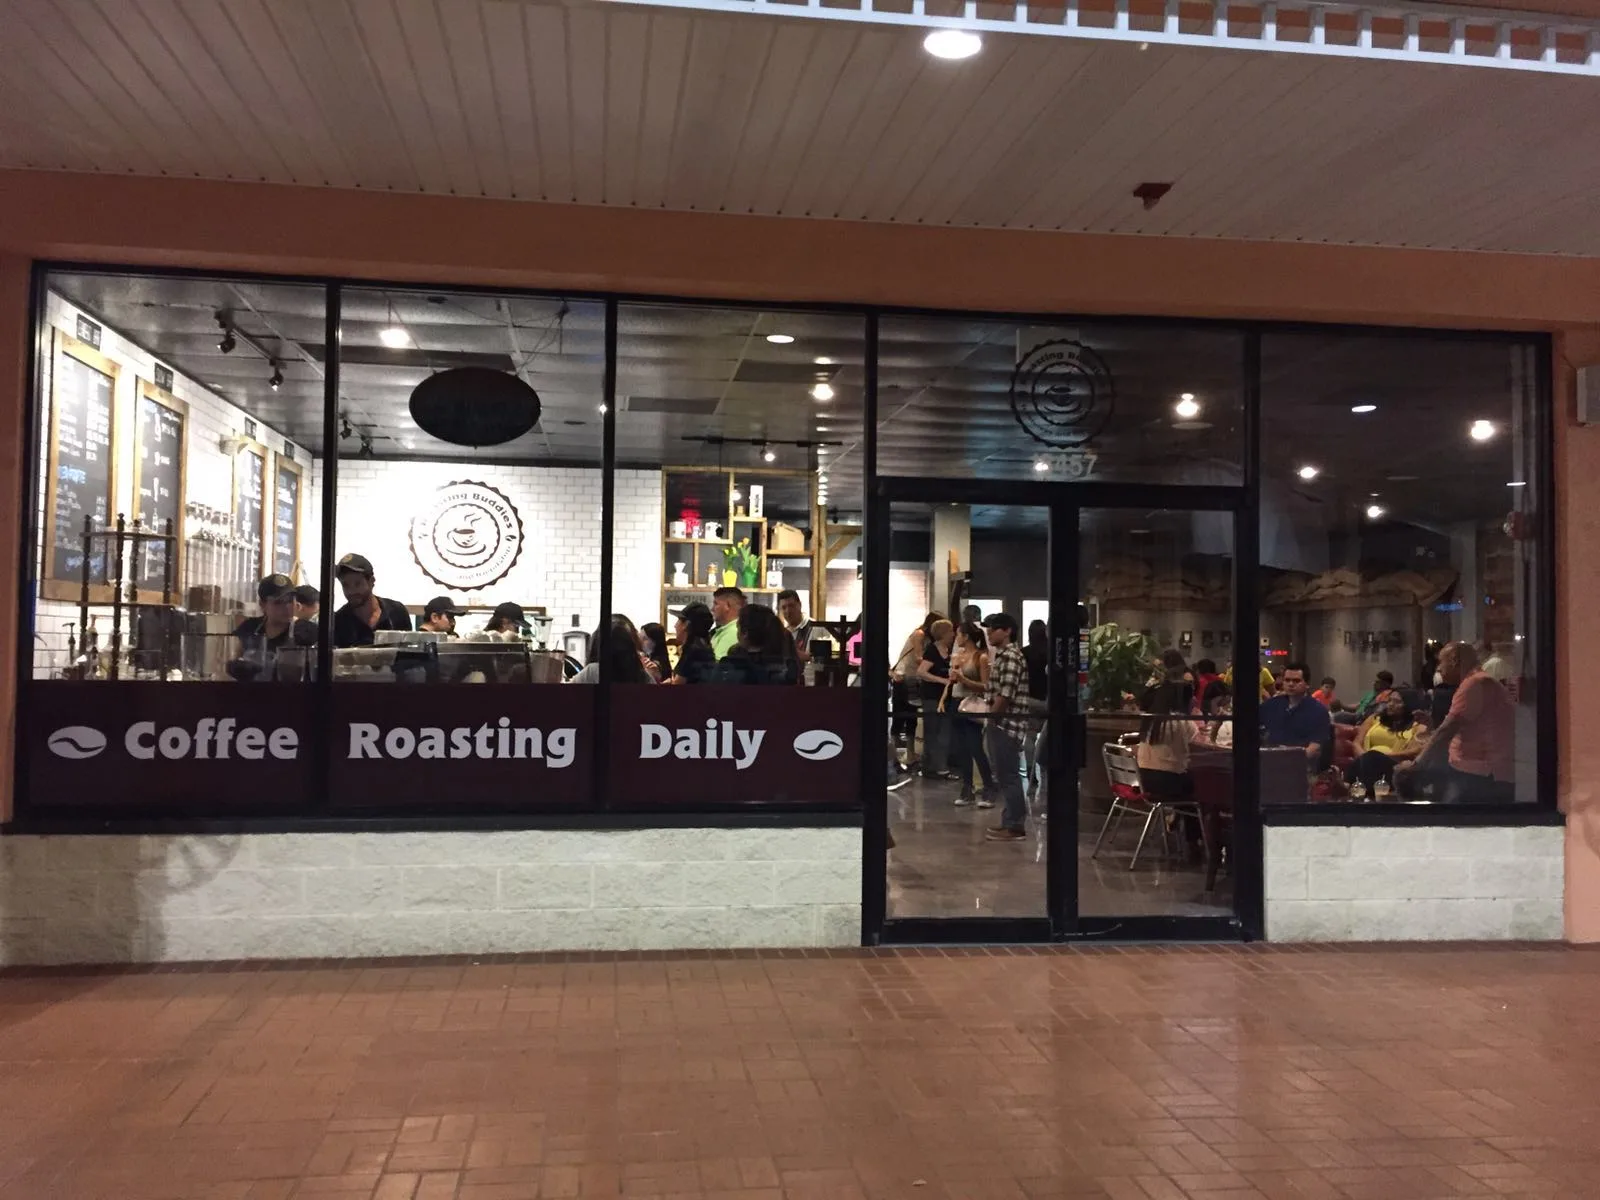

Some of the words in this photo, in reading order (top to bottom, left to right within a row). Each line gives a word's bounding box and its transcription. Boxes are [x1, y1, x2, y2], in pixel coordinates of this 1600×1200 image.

[473, 493, 513, 529] Buddies
[124, 718, 299, 760] Coffee
[347, 716, 577, 768] Roasting
[639, 718, 767, 770] Daily
